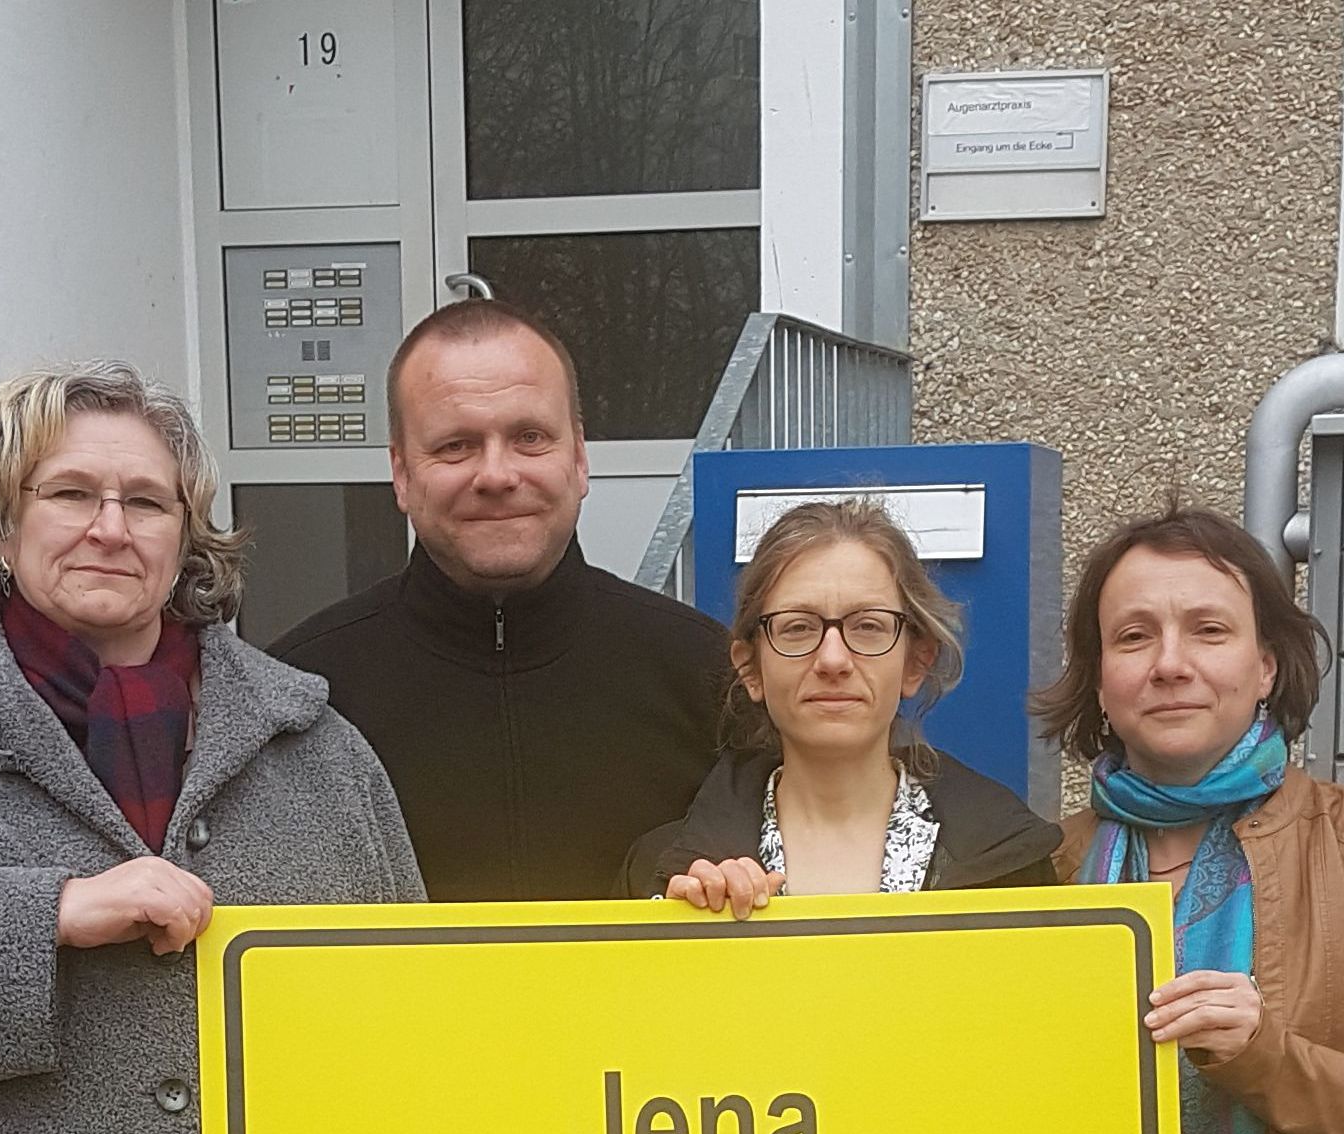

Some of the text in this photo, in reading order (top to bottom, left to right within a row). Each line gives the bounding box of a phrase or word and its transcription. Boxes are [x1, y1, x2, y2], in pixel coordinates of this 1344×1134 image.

[298, 32, 337, 66] 19
[947, 100, 1032, 114] Augenarztpraxis
[956, 143, 993, 154] Eingang
[1013, 142, 1026, 151] die
[1029, 141, 1053, 151] Ecke
